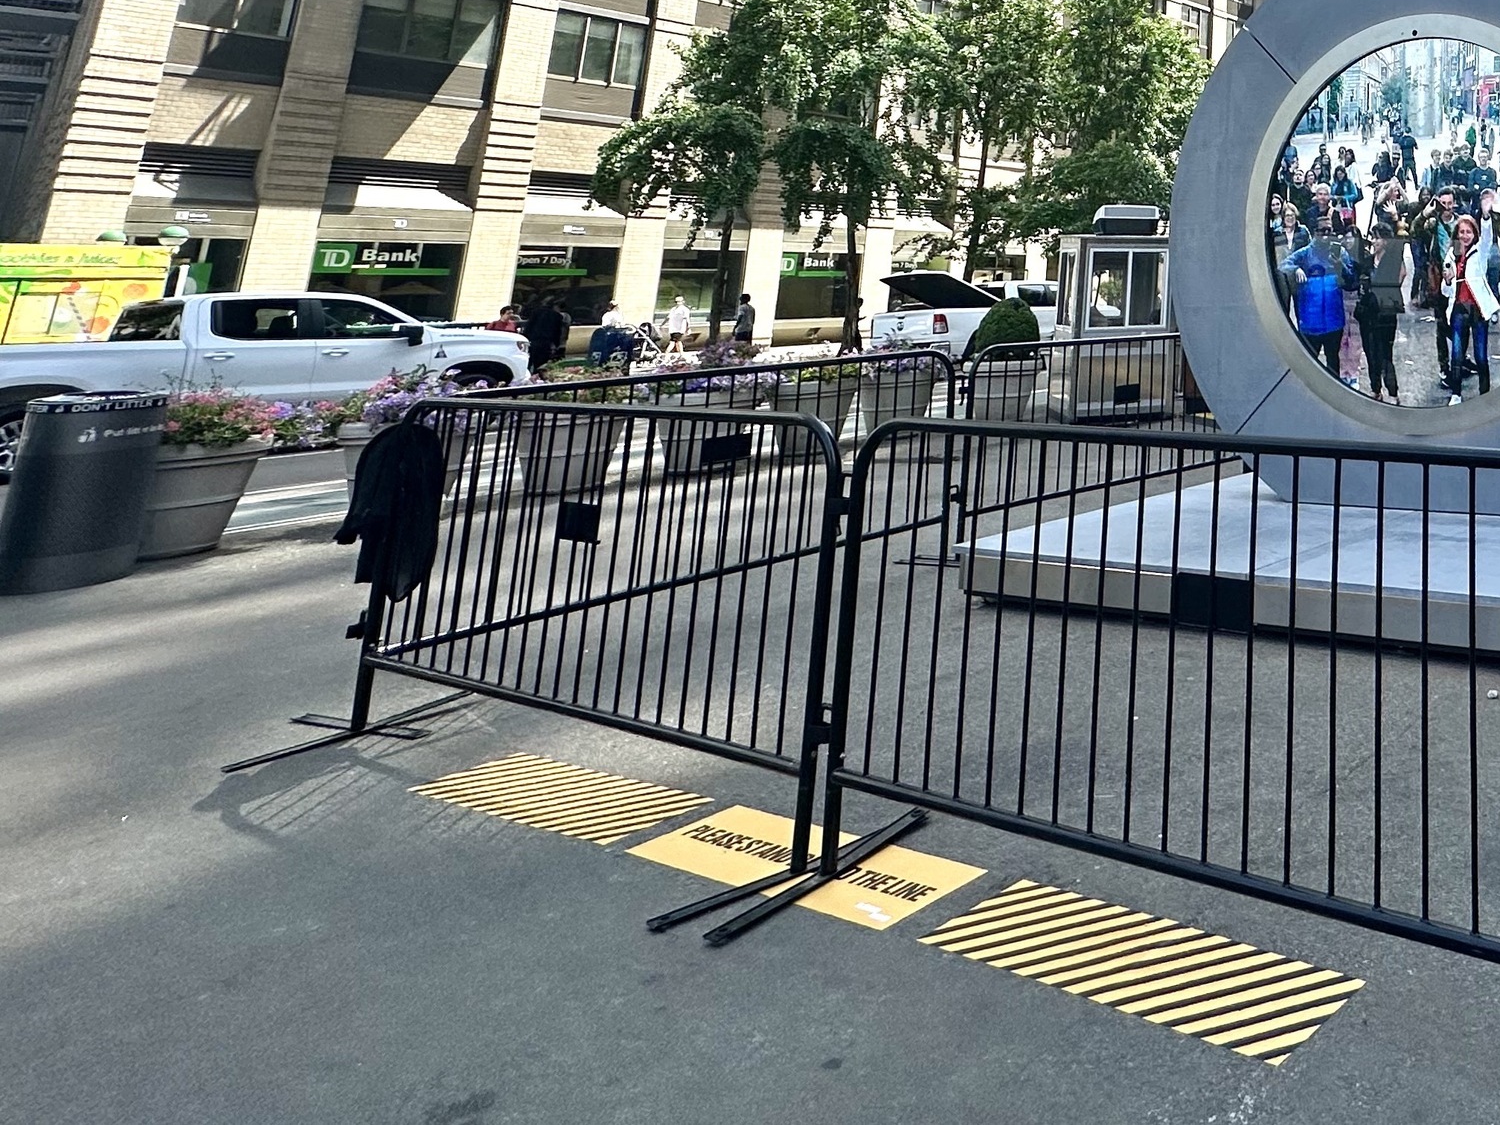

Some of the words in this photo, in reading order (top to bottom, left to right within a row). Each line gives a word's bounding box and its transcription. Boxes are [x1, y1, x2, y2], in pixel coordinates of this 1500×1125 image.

[320, 249, 351, 267] TD
[361, 249, 418, 262] Bank
[542, 256, 549, 264] 7
[550, 256, 572, 266] Days
[782, 257, 795, 272] D
[803, 257, 835, 267] Bank
[71, 402, 112, 413] DON'T
[115, 400, 153, 410] LITTER
[103, 428, 125, 438] Put
[681, 824, 754, 849] PLEASE
[735, 839, 793, 863] STAND
[848, 870, 898, 891] THE
[880, 879, 938, 902] LINE
